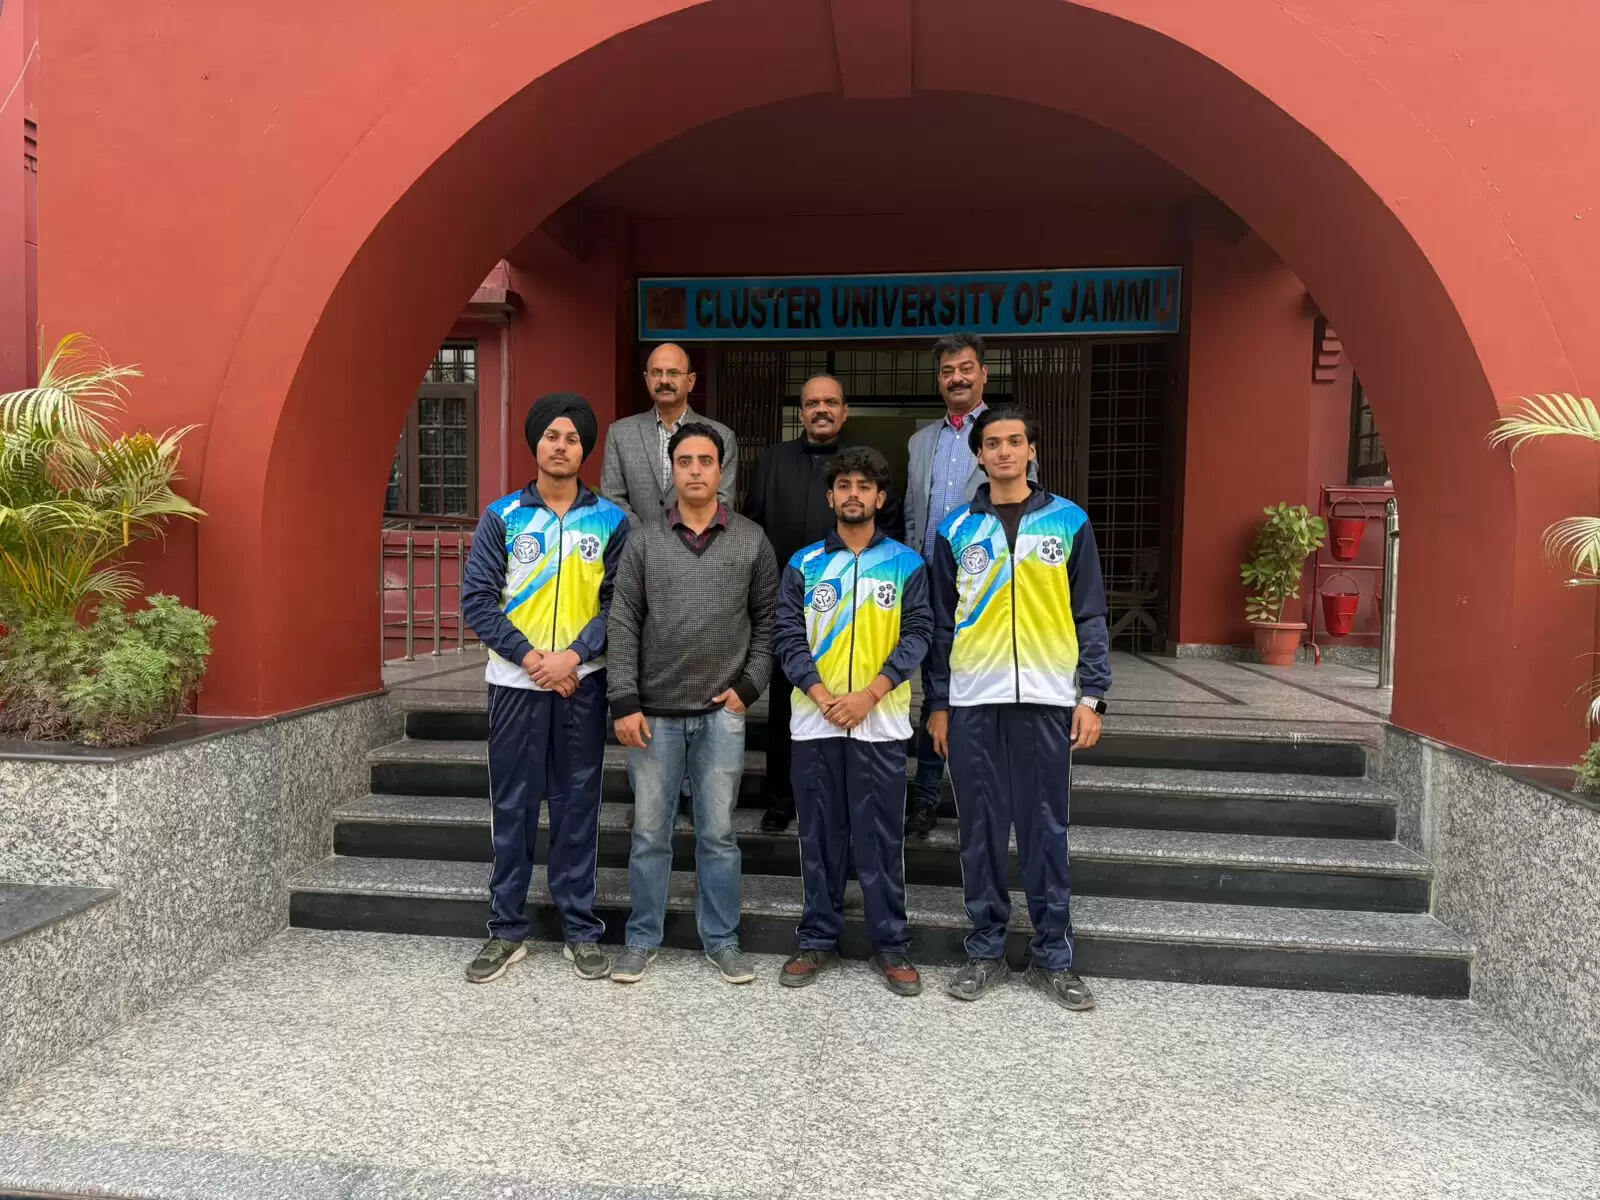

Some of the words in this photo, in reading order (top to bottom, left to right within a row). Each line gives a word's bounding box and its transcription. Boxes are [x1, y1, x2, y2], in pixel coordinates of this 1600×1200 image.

[695, 287, 821, 329] CLUSTER
[832, 284, 1007, 328] UNIVERSITY
[1013, 280, 1053, 326] OF
[1061, 278, 1173, 324] JAMMU
